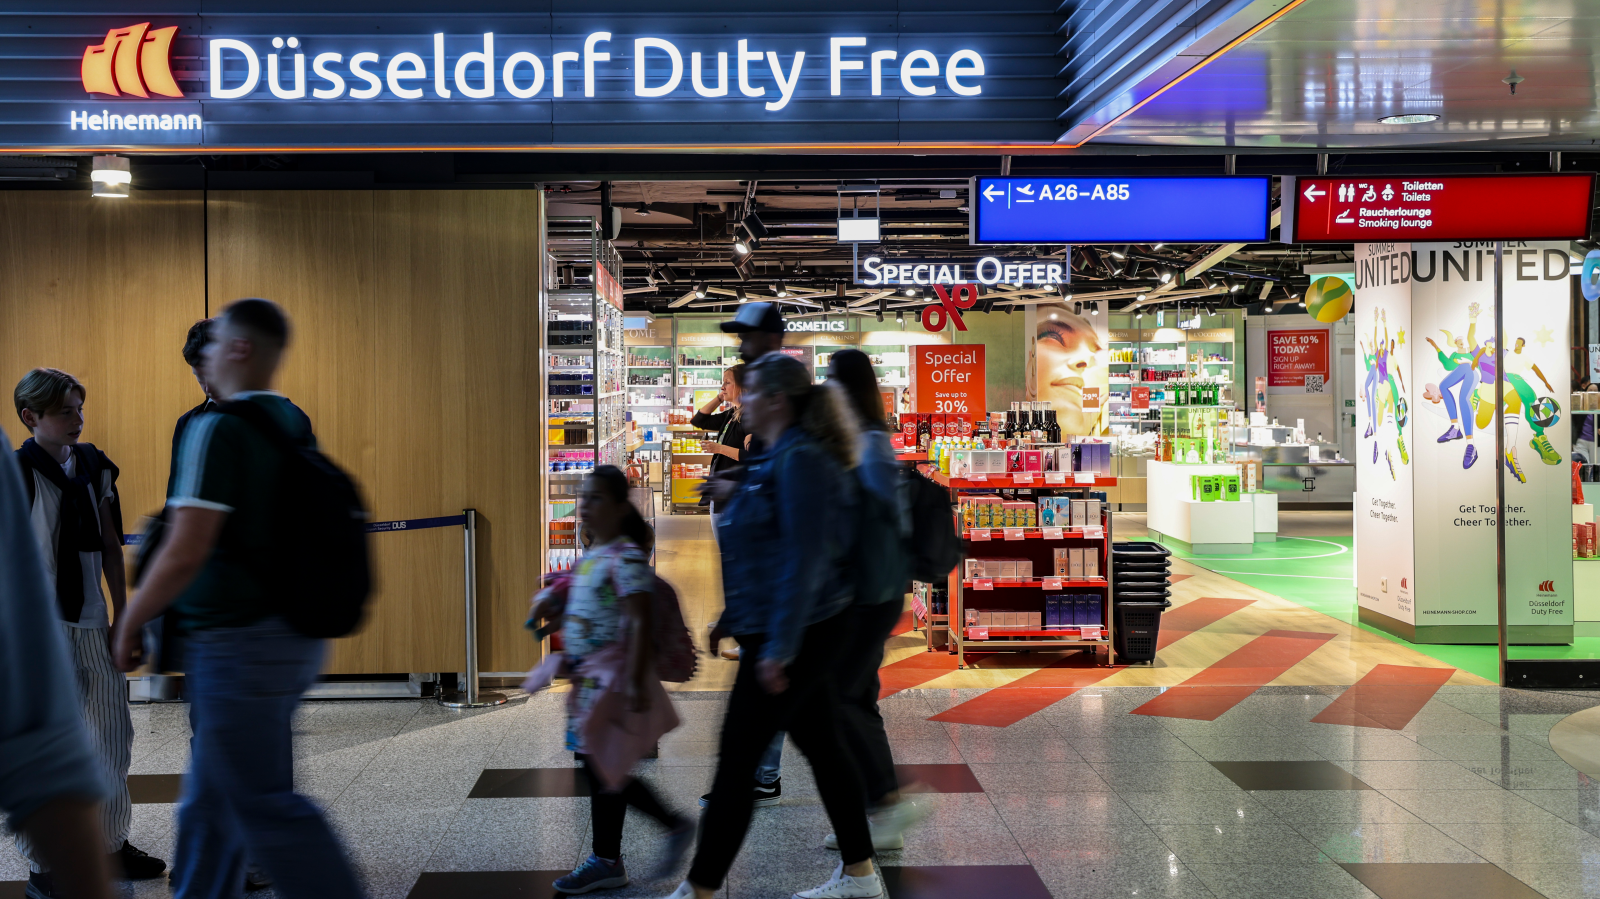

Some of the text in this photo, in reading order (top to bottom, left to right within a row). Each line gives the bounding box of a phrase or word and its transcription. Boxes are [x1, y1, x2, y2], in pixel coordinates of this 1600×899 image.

[209, 32, 985, 111] Düsseldorf Duty Free
[70, 110, 202, 131] Heinemann
[1402, 181, 1444, 191] Toiletten
[1401, 192, 1431, 202] Toilets
[1359, 207, 1432, 218] Raucherlounge
[1358, 218, 1433, 229] Smoking lounge
[1368, 242, 1396, 257] SUMMER
[1354, 251, 1412, 290] UNITED
[1273, 336, 1297, 344] SAVE
[924, 350, 977, 367] Special
[931, 369, 972, 383] Offer
[951, 392, 960, 400] up
[935, 400, 969, 414] 30%
[1371, 498, 1397, 510] Get Together.
[1459, 504, 1526, 515] Get Togher.
[1369, 510, 1399, 523] Cheer Together.
[1453, 517, 1532, 527] Cheer Toether.
[392, 521, 407, 530] DUS
